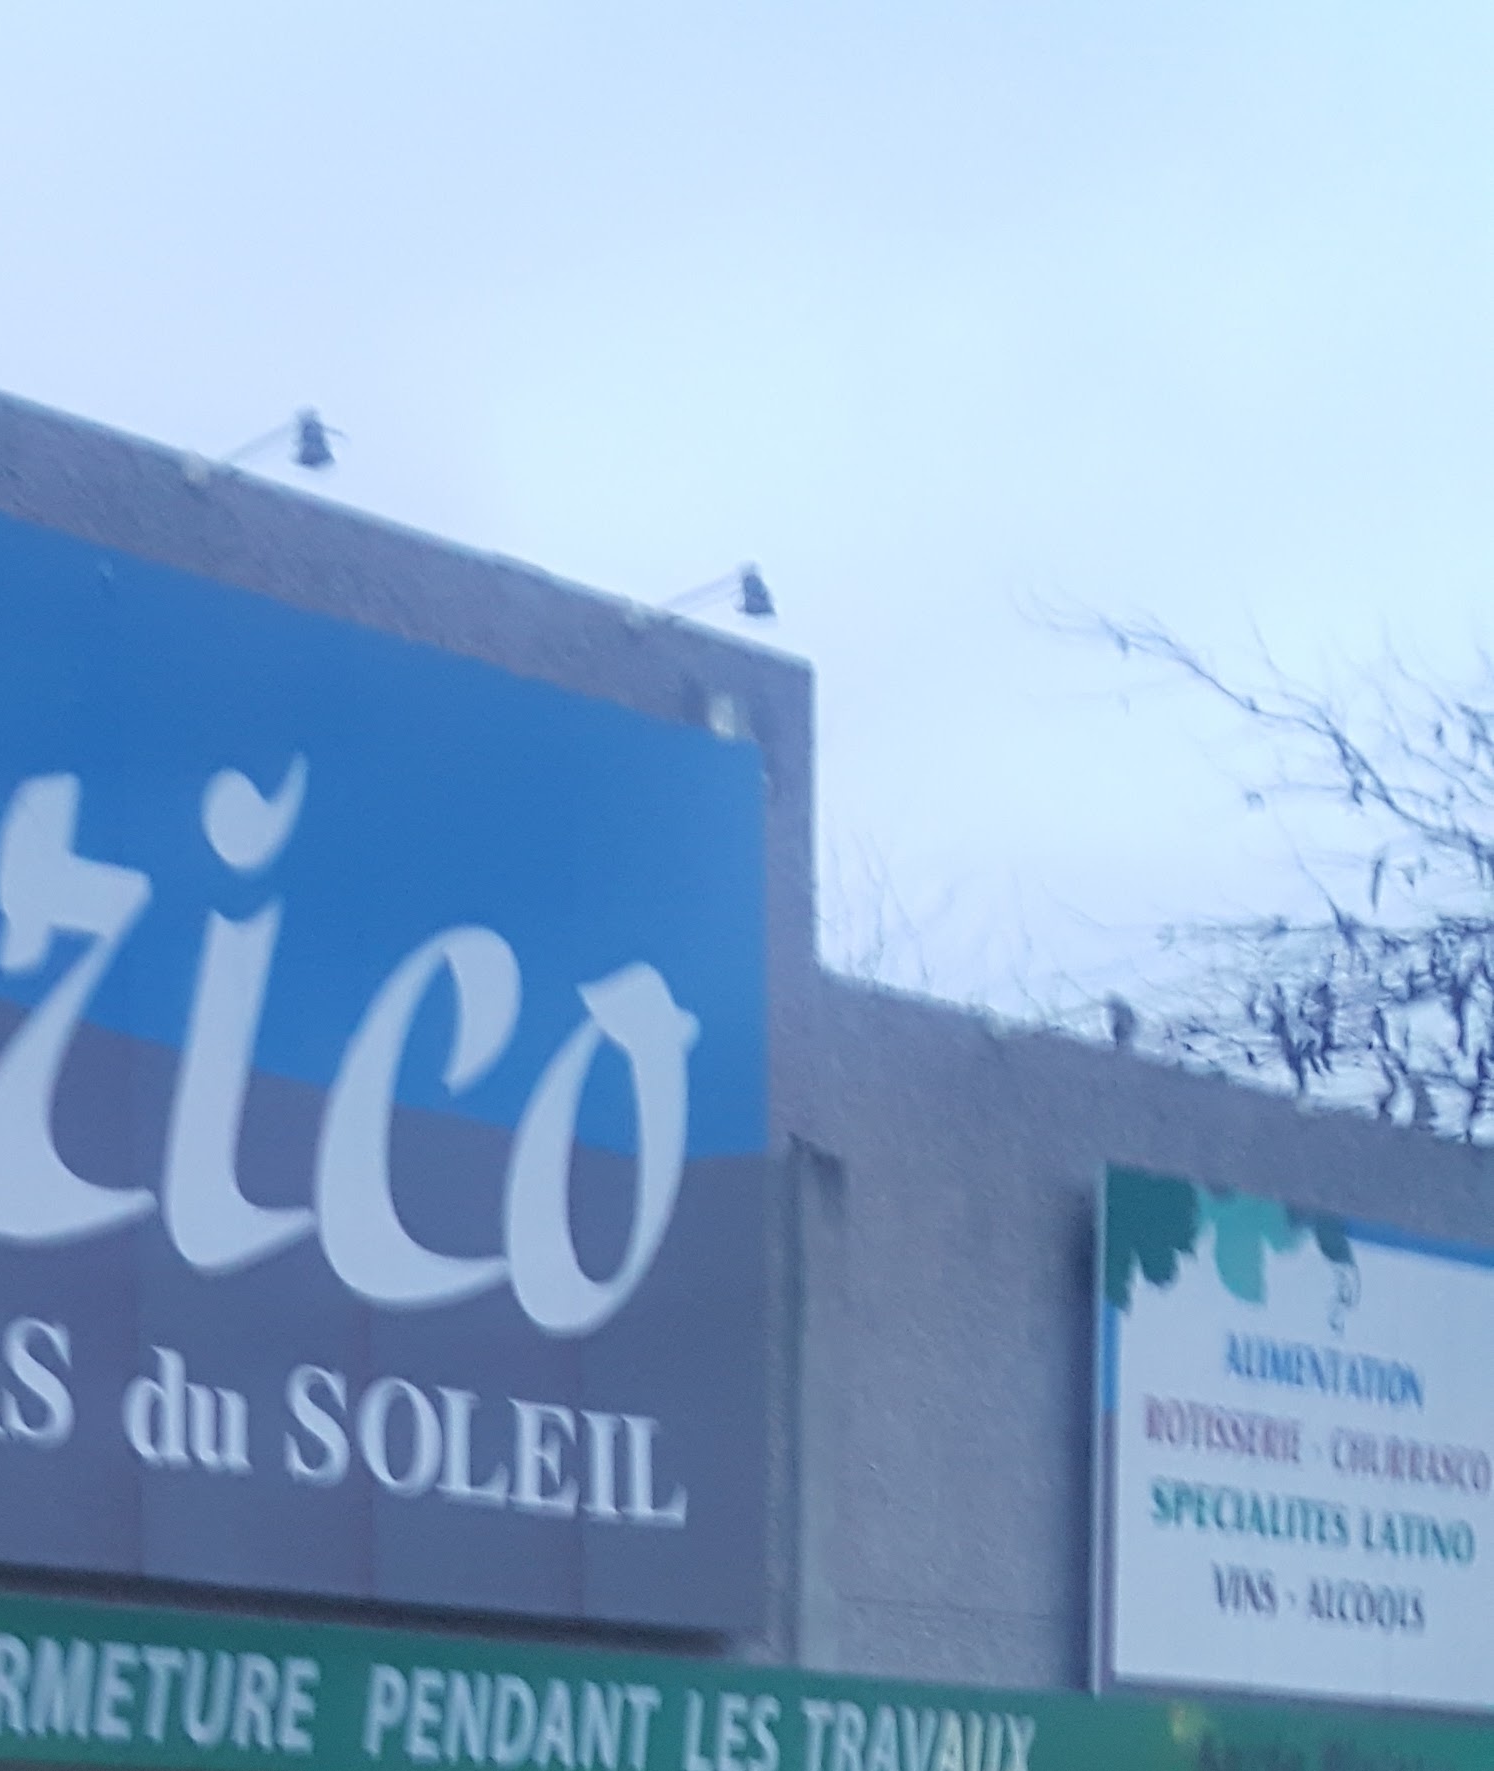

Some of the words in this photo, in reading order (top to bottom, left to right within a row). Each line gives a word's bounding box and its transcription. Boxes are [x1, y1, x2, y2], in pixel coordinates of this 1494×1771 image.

[1225, 1334, 1424, 1406] ALIMENTATION
[124, 1346, 252, 1478] du
[286, 1364, 690, 1526] SOLEIL
[1362, 1506, 1475, 1564] LATINO
[1210, 1562, 1278, 1618] VINS
[1308, 1580, 1428, 1632] ALCOOLS
